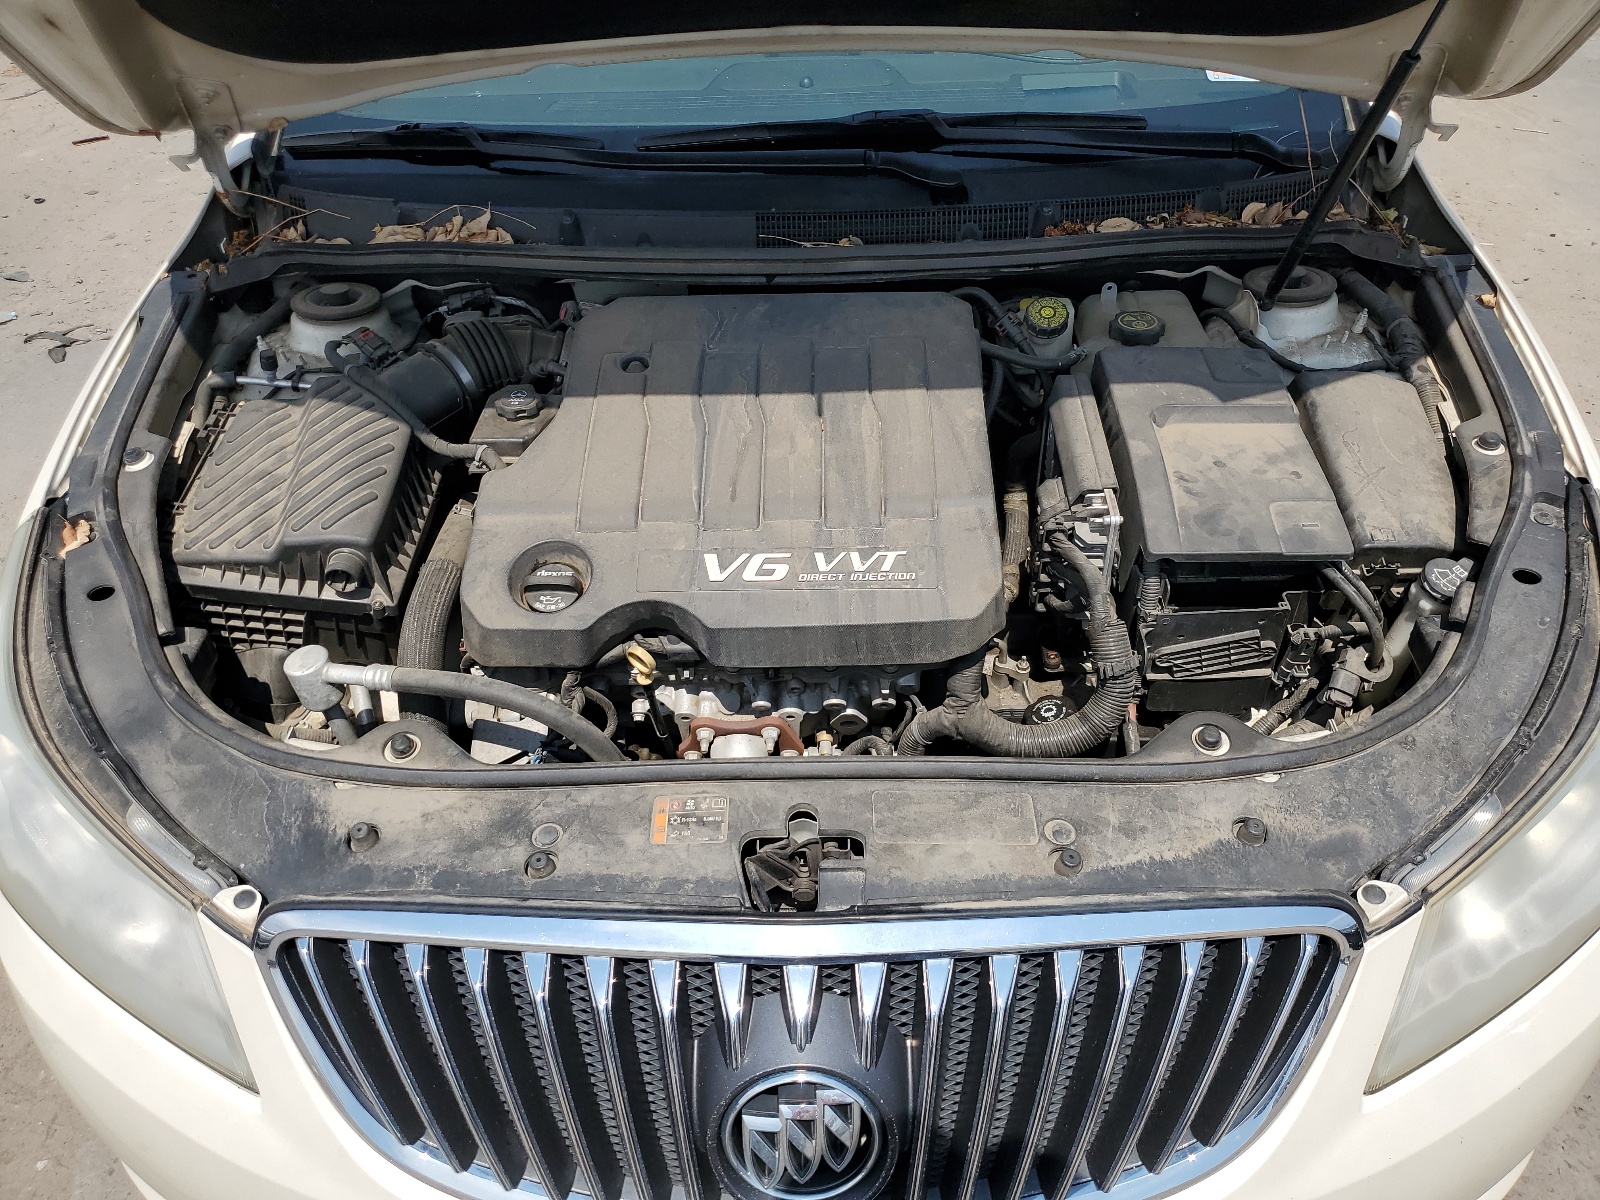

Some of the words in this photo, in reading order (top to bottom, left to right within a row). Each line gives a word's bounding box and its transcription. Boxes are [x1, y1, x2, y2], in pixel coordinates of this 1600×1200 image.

[703, 552, 792, 582] V6
[813, 551, 907, 572] VVT
[798, 573, 846, 582] DIRECT
[849, 572, 916, 581] INJECTION
